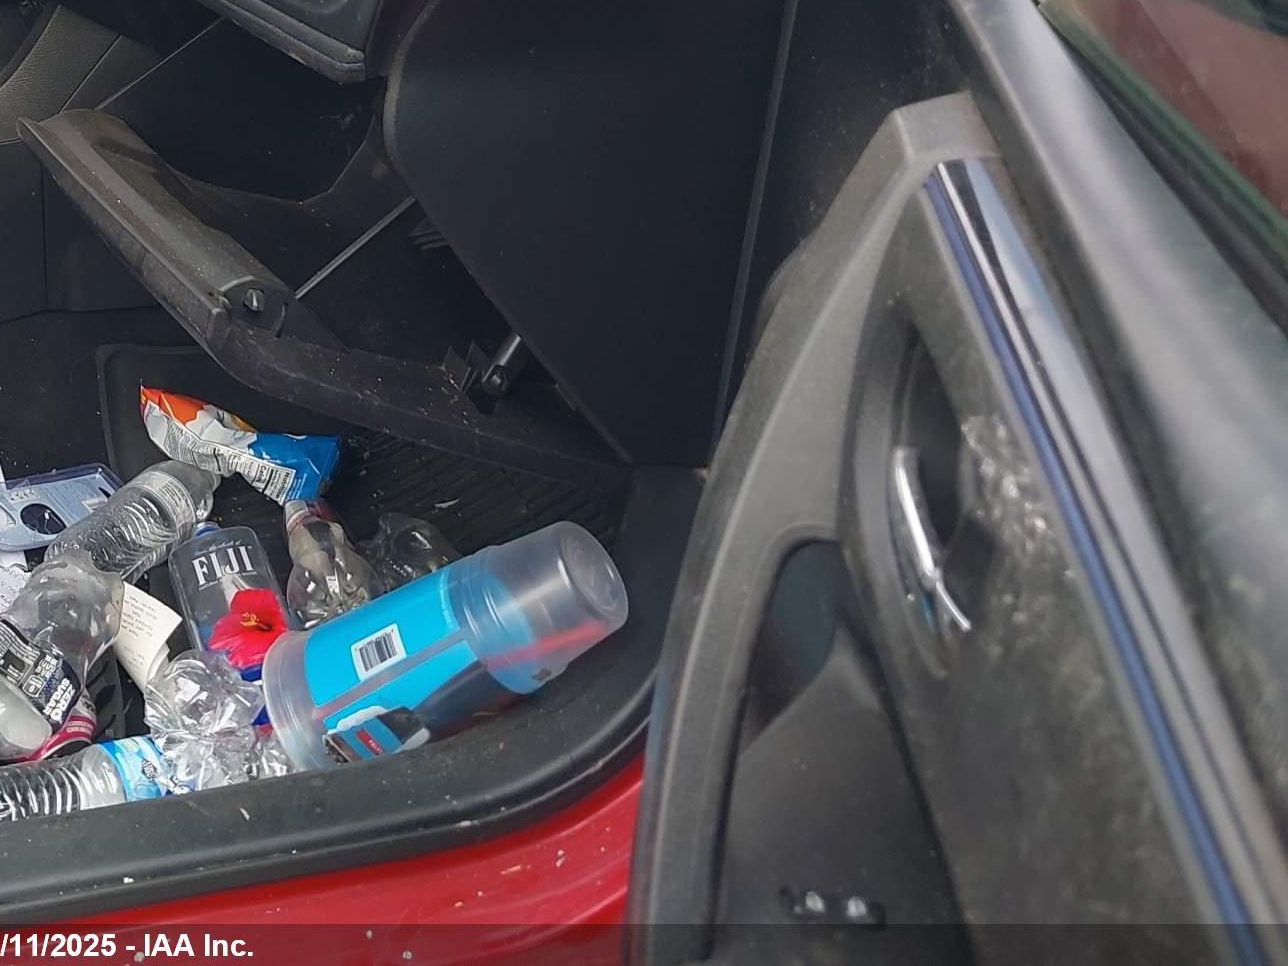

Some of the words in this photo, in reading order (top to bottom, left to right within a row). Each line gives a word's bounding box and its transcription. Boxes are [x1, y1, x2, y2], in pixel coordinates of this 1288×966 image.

[192, 545, 254, 587] FIJI
[42, 677, 70, 715] SUGAR
[50, 683, 75, 724] ZERO
